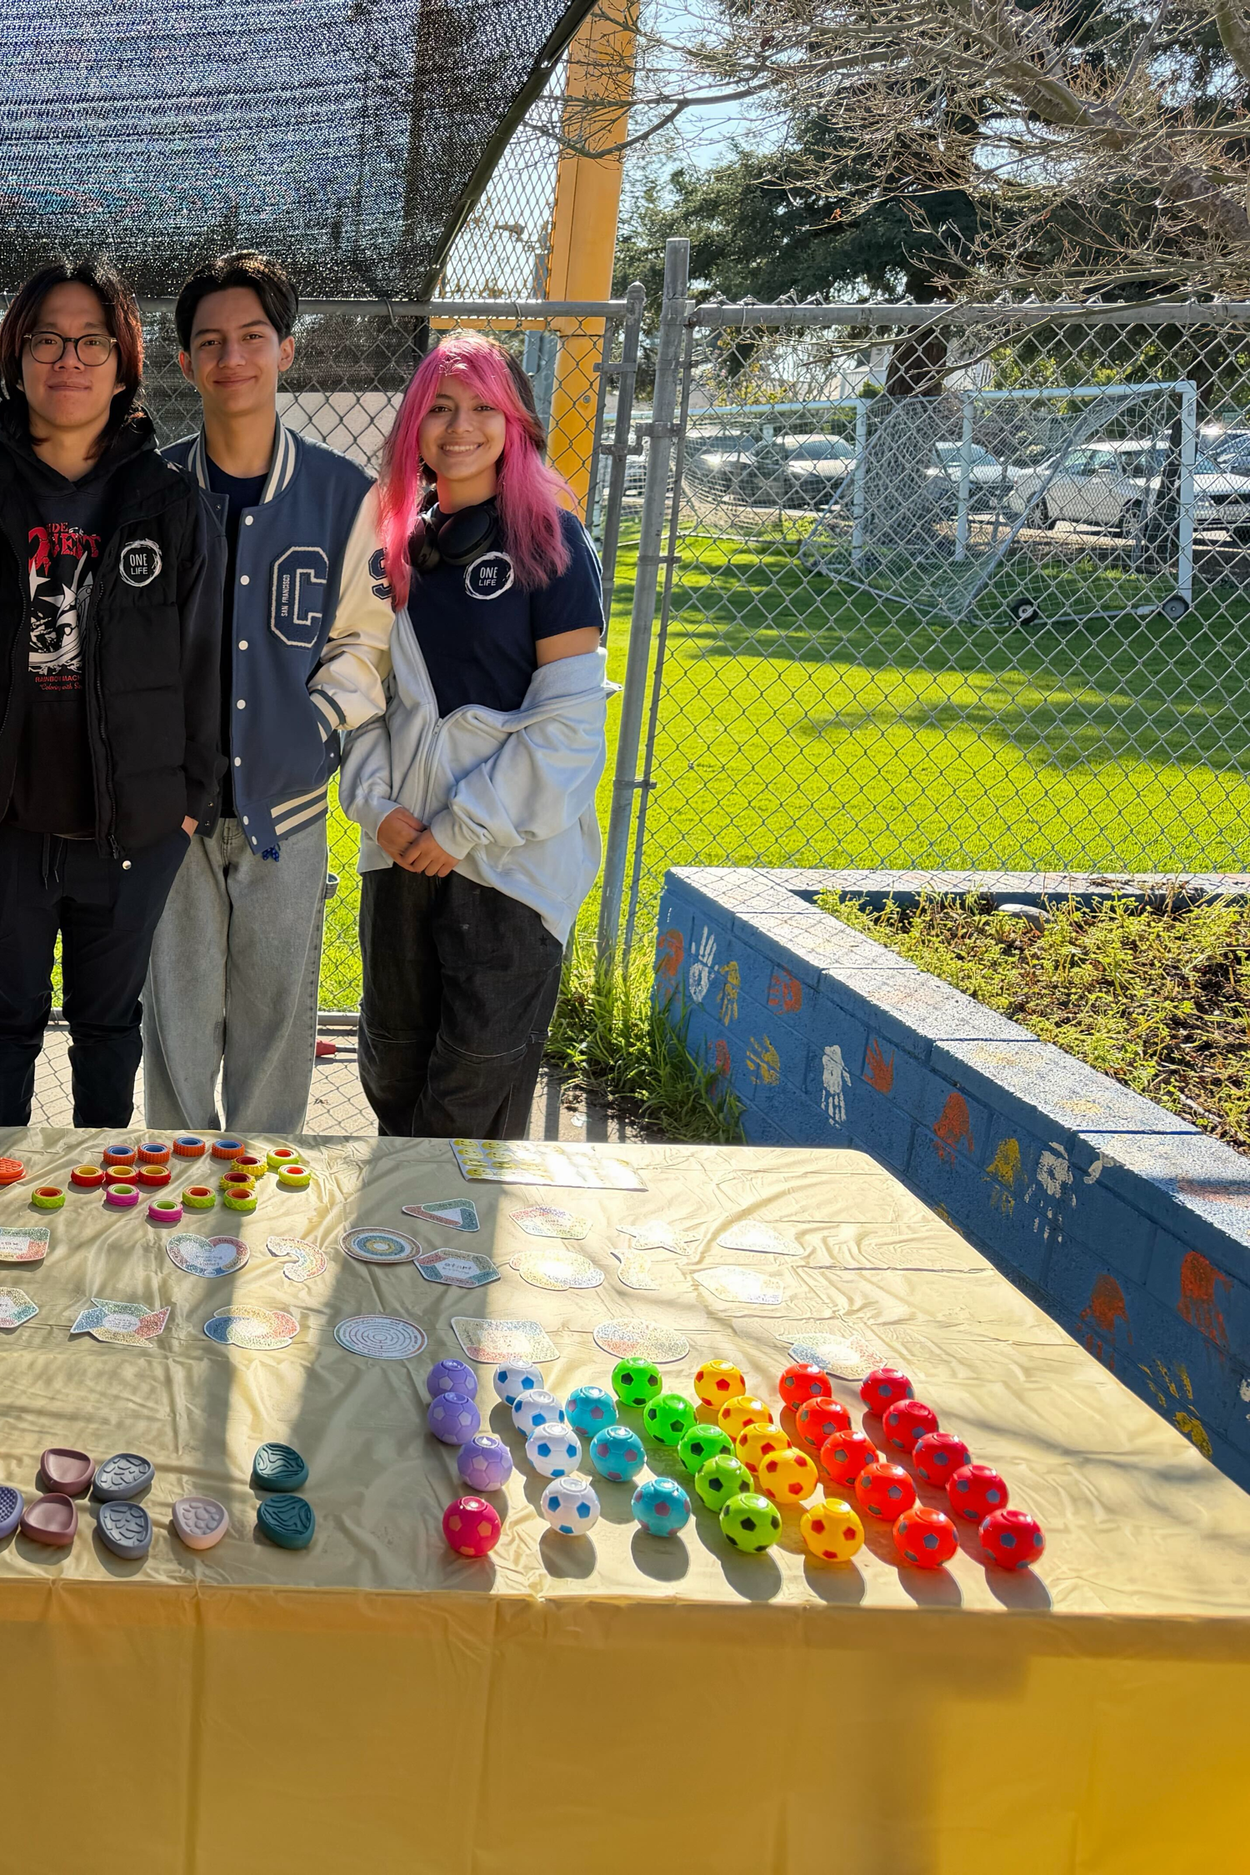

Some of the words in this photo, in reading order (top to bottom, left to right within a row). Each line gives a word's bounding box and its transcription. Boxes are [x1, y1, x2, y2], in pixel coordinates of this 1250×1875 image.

[129, 553, 148, 567] ONE
[130, 567, 149, 575] LIFE
[479, 566, 498, 580] ONE
[281, 574, 290, 604] FRANCISCO
[478, 579, 497, 587] LIFE
[270, 546, 330, 649] C
[280, 605, 289, 617] SAN
